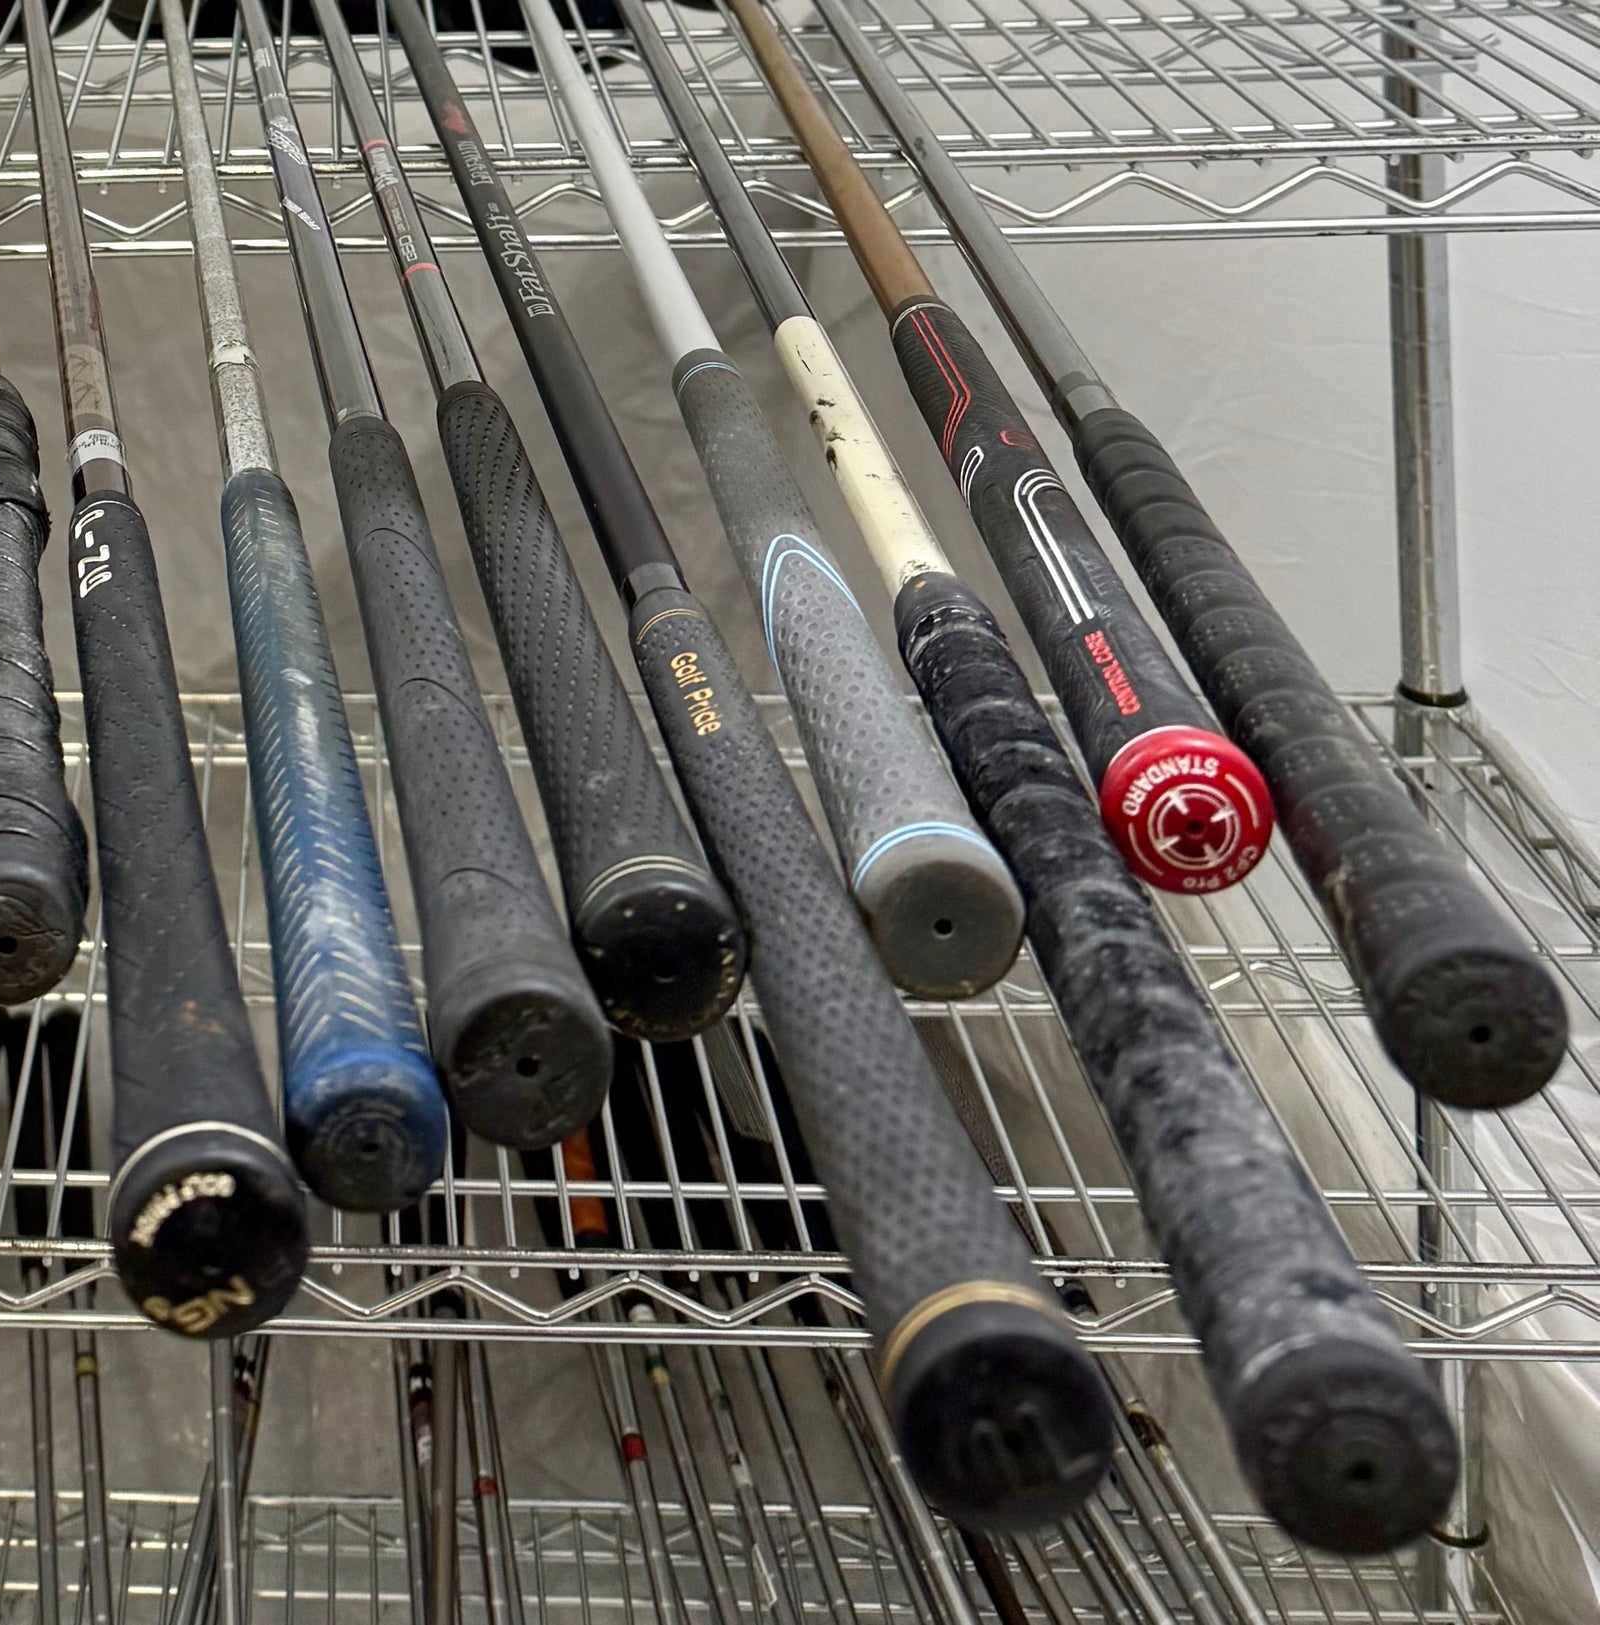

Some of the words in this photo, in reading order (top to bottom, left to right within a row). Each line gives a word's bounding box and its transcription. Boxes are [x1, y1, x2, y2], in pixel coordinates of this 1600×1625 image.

[1084, 630, 1114, 665] CORE
[670, 651, 708, 689] Golf
[1102, 659, 1141, 716] CONTROL
[683, 687, 723, 737] Pride
[1121, 753, 1220, 817] STANDARD
[1182, 874, 1221, 890] Pro
[1223, 845, 1259, 882] CP2
